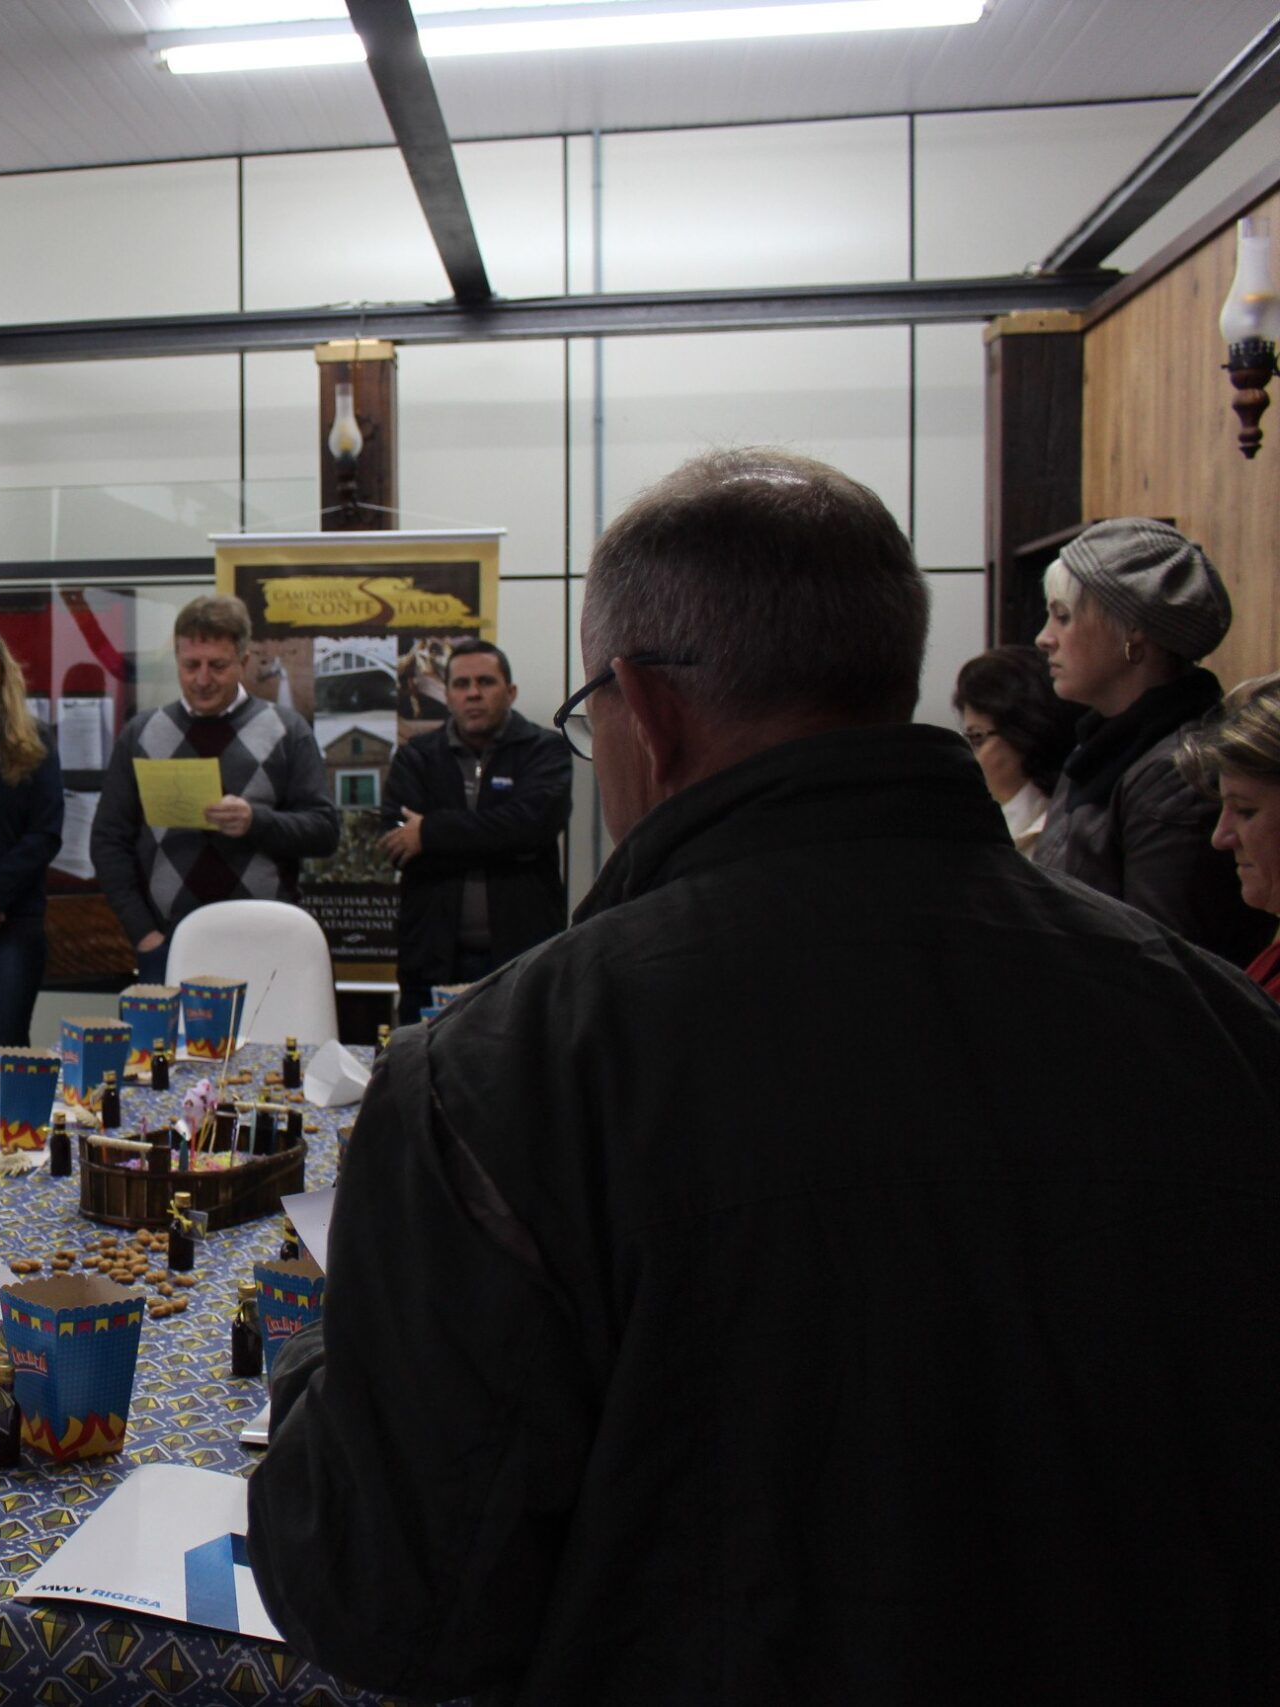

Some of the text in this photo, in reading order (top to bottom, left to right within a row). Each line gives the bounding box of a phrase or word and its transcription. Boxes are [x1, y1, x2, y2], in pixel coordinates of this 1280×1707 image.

[272, 589, 352, 601] CAMINHOS
[35, 1584, 162, 1609] MWV RIGESA
